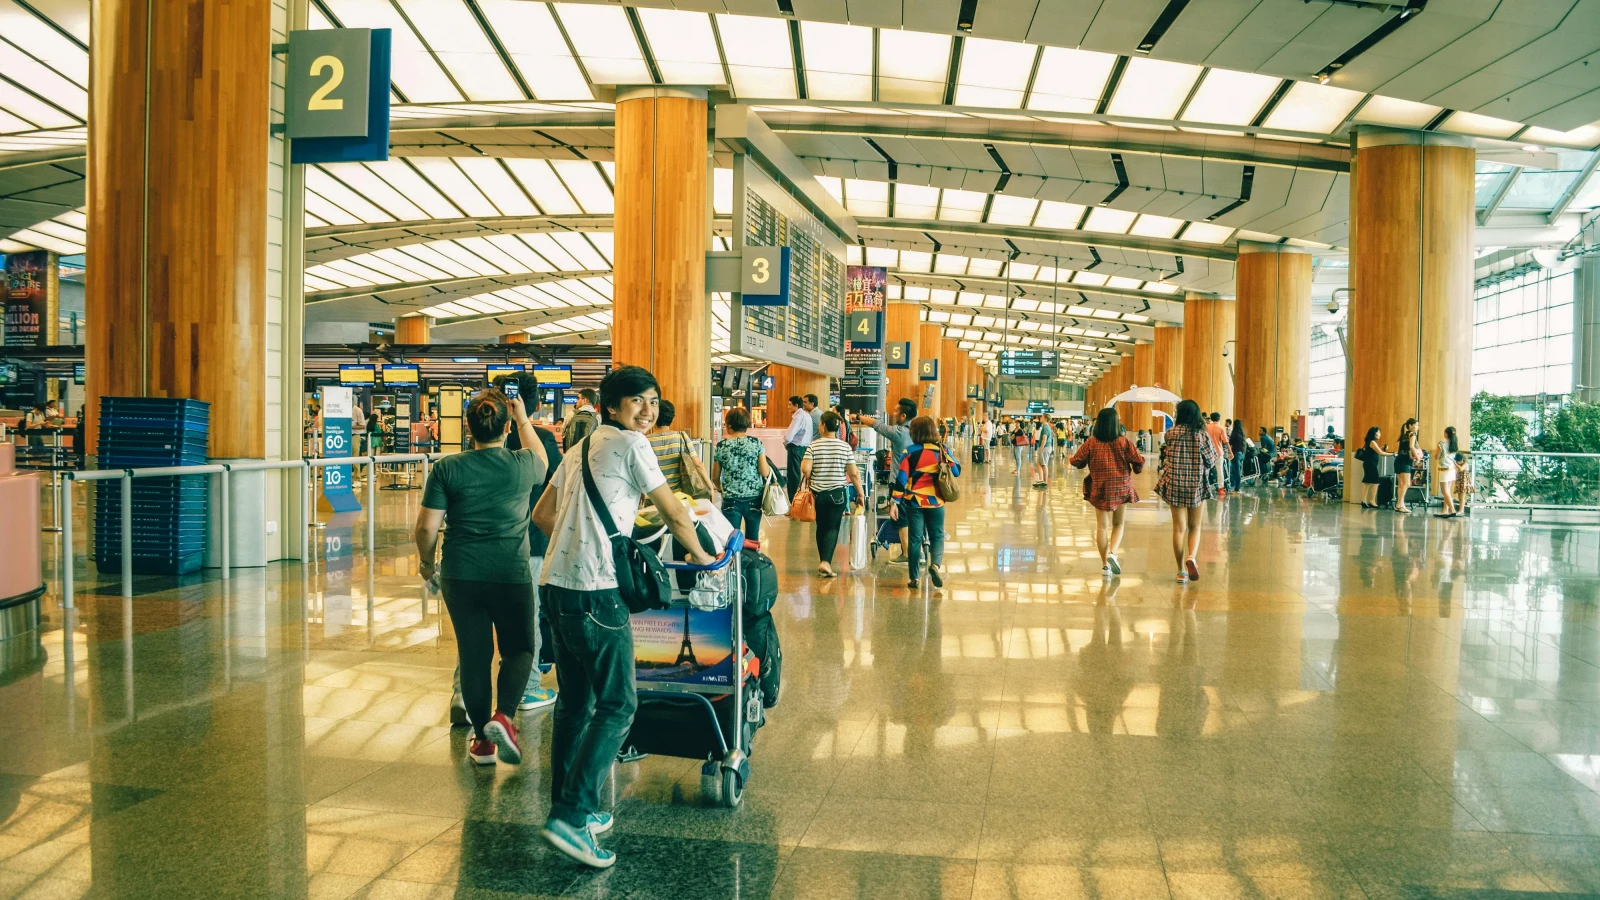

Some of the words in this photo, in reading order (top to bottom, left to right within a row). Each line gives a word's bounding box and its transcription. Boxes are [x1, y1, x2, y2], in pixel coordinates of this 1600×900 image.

[308, 55, 344, 110] 2
[752, 257, 770, 284] 3
[857, 318, 870, 335] 4
[892, 347, 901, 360] 5
[923, 362, 931, 374] 6
[763, 377, 773, 388] 4
[969, 386, 975, 394] 7
[326, 435, 343, 449] 60
[326, 470, 341, 485] 10
